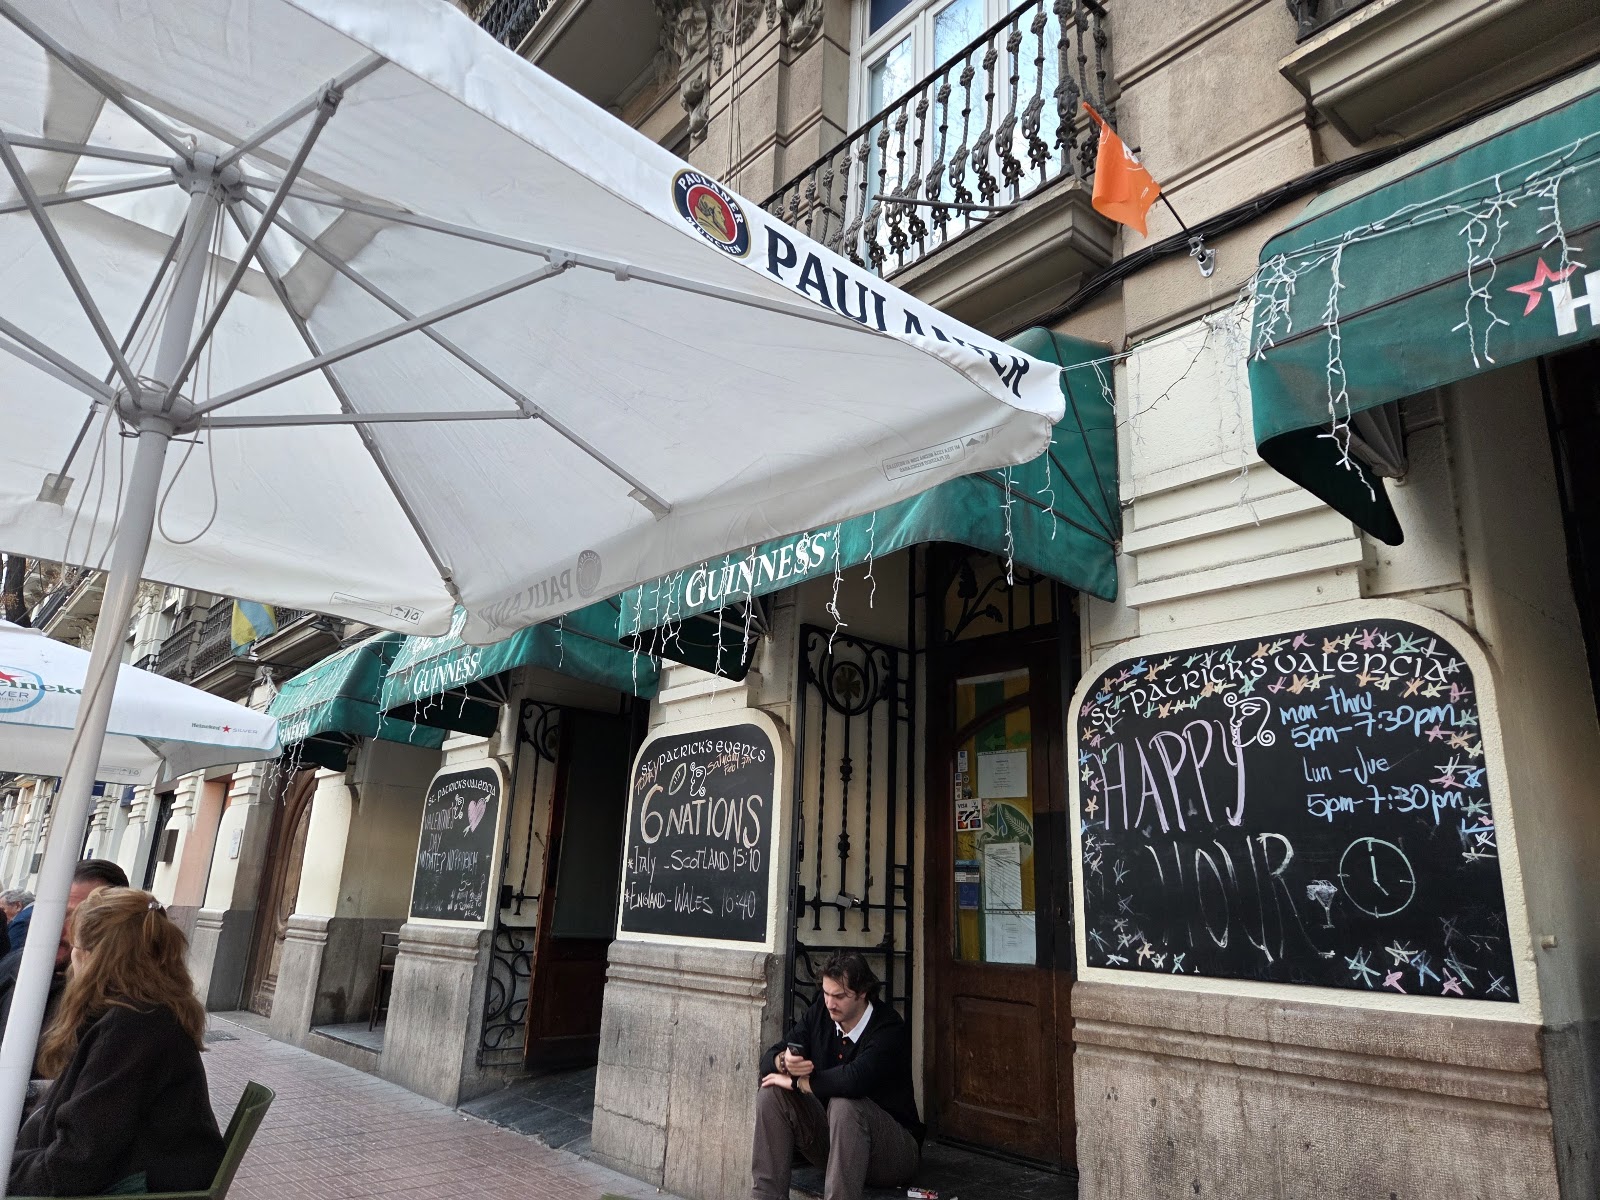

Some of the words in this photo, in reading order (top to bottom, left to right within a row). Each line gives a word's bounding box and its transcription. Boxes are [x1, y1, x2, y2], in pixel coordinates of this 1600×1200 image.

[678, 172, 744, 224] PAULANER
[685, 532, 828, 608] GUINNESS
[413, 652, 479, 695] GUINNESS
[1274, 652, 1448, 683] VALENCIA
[1093, 719, 1246, 834] HAPPY
[640, 784, 664, 844] 6
[665, 794, 763, 848] NATIONS
[732, 846, 761, 872] 15:10
